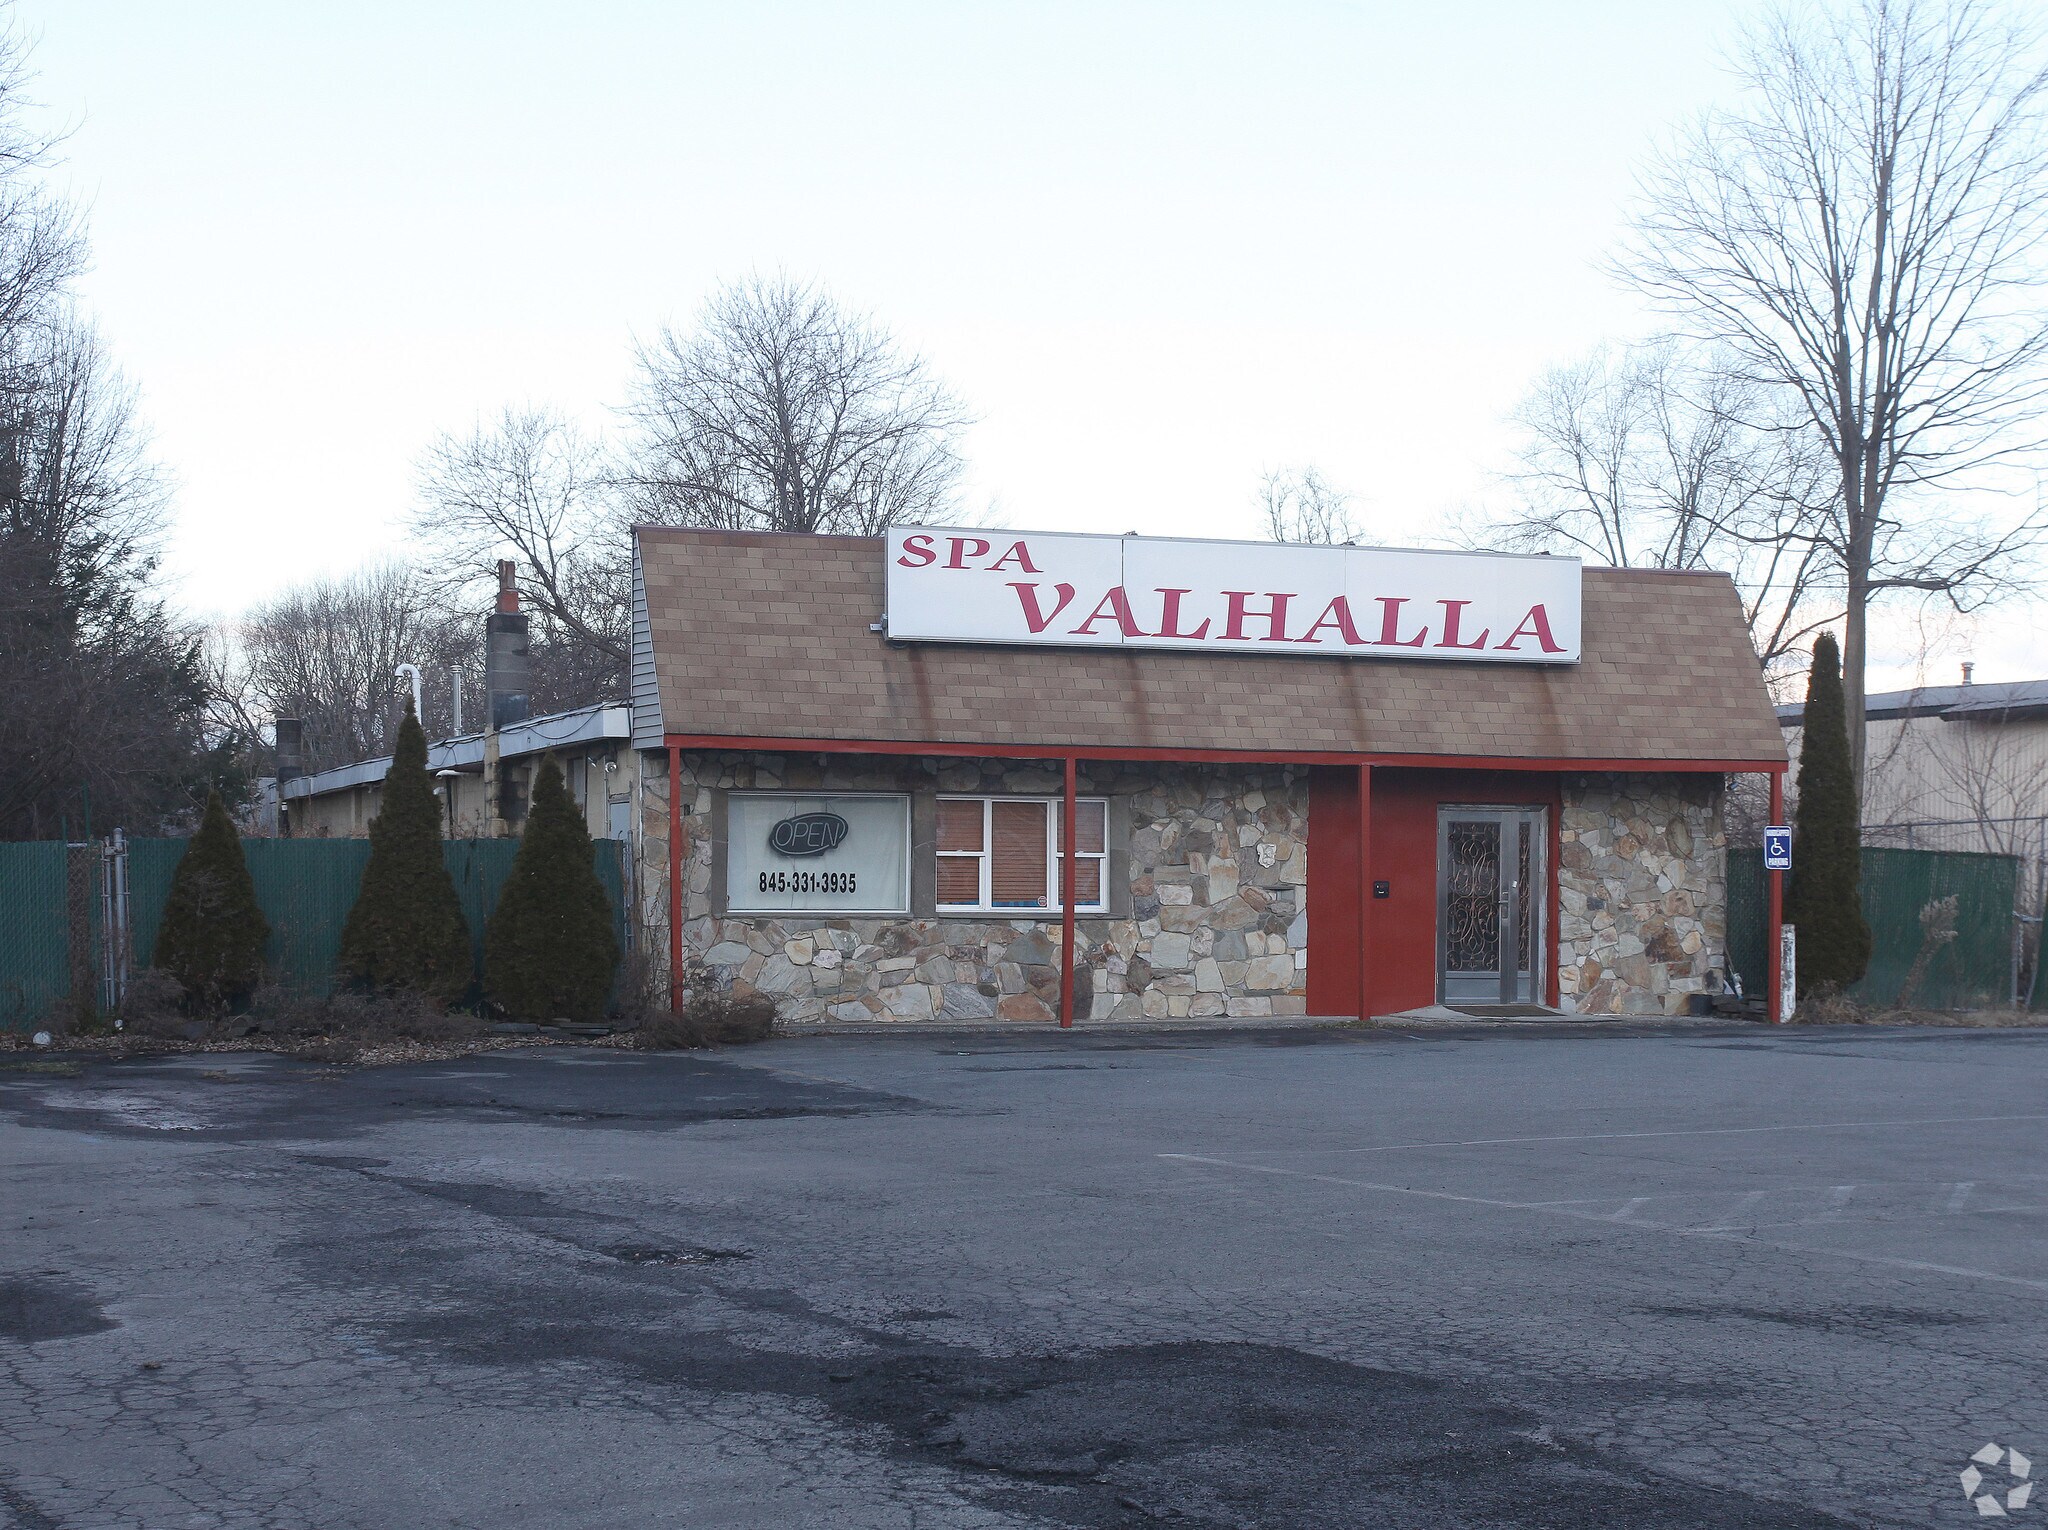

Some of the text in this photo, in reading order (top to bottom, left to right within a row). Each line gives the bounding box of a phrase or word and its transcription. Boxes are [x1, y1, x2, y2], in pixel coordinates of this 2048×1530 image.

[897, 535, 1044, 573] SPA
[1005, 582, 1568, 653] VALHALLA
[775, 822, 840, 847] OPEN
[759, 871, 857, 894] 845-331-3935
